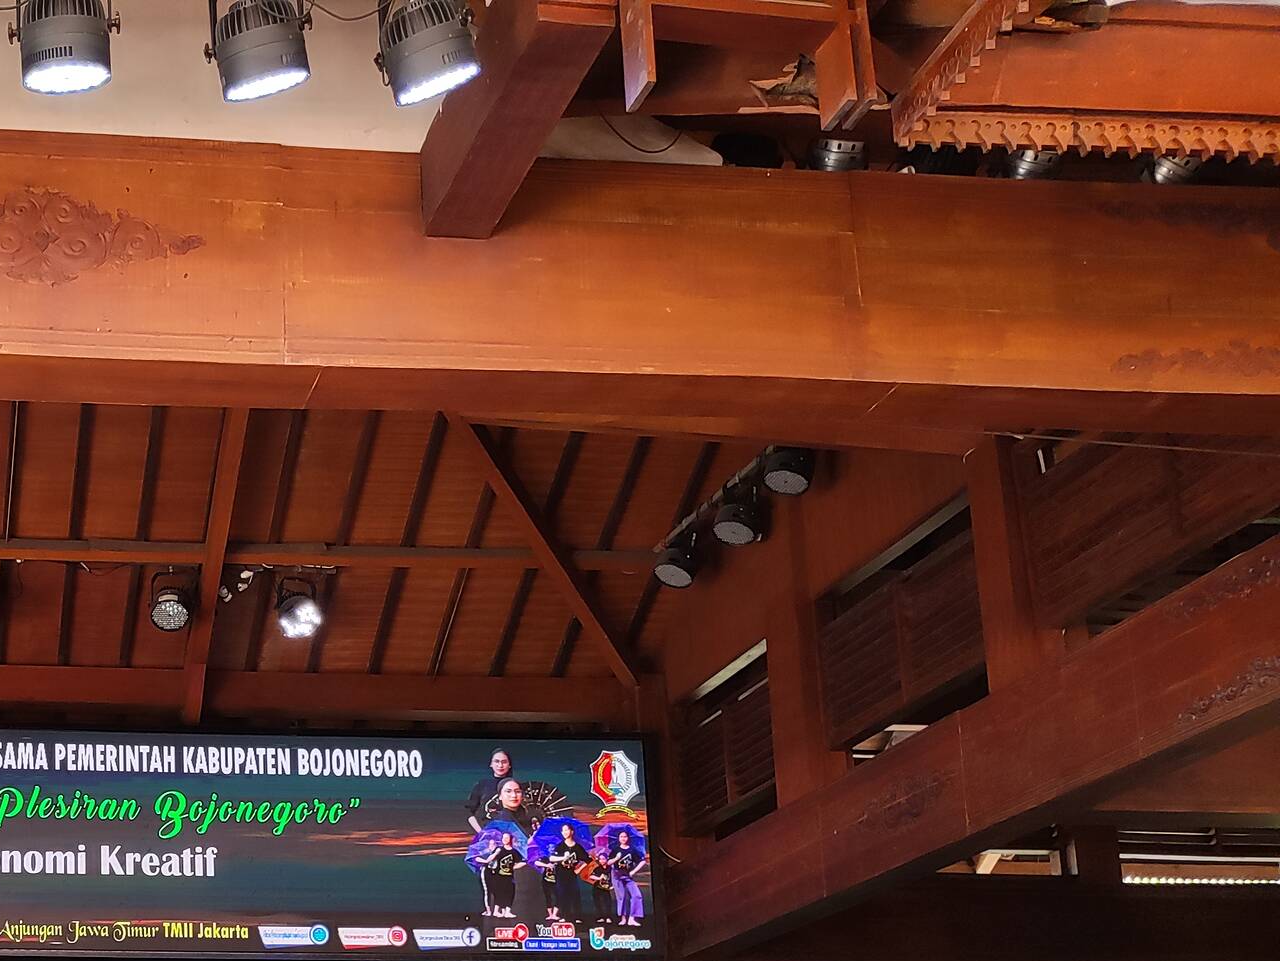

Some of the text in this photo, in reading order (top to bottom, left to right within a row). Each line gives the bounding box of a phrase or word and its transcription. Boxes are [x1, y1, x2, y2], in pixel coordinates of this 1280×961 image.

[54, 743, 176, 773] PEMERINTAH
[182, 746, 291, 775] KABUPATEN
[297, 747, 423, 778] BOJONEGORO
[154, 790, 360, 839] Bojonegoro”
[100, 844, 218, 877] Kreatif
[66, 920, 111, 944] Jawa
[112, 920, 162, 942] Timur
[162, 919, 196, 938] TMII
[197, 921, 249, 939] Jakarta
[496, 930, 514, 939] LIVE
[536, 924, 574, 938] YouTube
